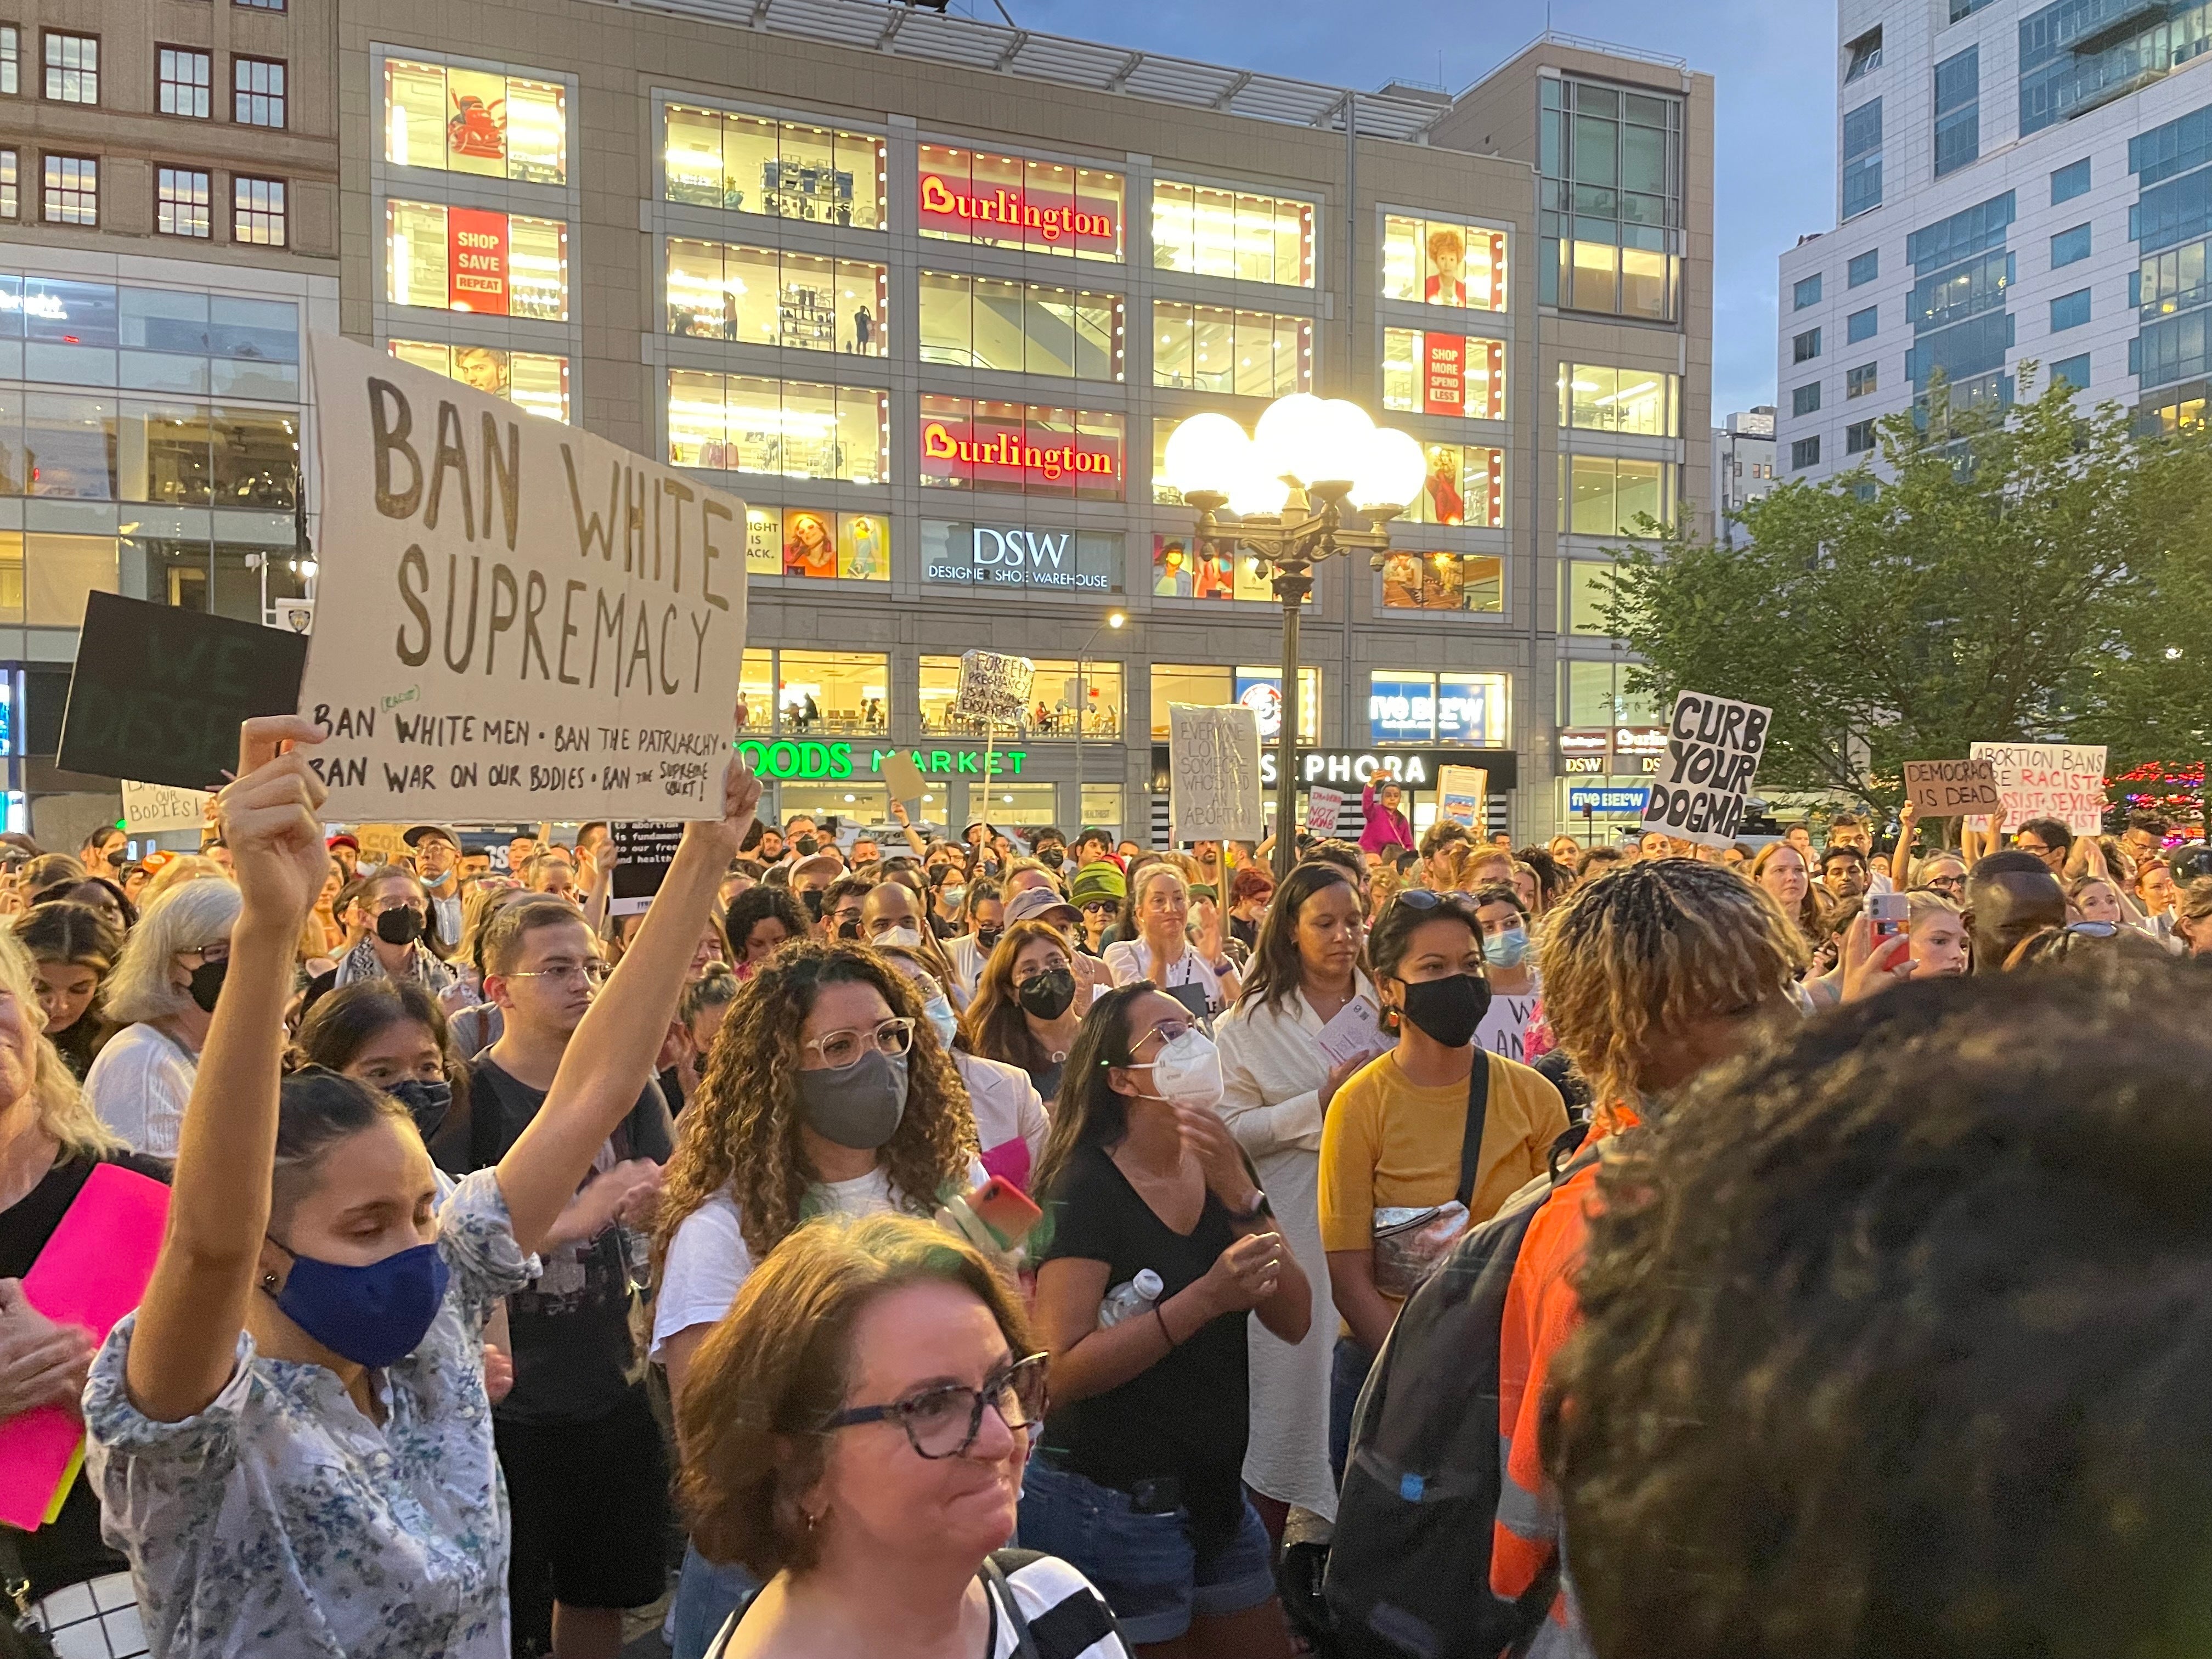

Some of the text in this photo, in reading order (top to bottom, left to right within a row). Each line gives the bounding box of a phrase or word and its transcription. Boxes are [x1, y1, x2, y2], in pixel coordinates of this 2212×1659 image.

[922, 176, 1111, 240] Burlington
[458, 232, 499, 250] SHOP
[458, 253, 500, 272] SAVE
[459, 277, 499, 290] REPEAT
[1431, 348, 1458, 362] SHOP
[1431, 362, 1458, 375] MORE
[1431, 376, 1459, 388] SPEND
[1435, 390, 1454, 401] LESS
[924, 422, 1113, 480] Burlington
[368, 377, 733, 611] BAN WHITE
[746, 522, 779, 533] IGHT
[751, 535, 761, 544] IS
[974, 528, 1070, 569] DSW
[929, 565, 1107, 588] DESIGNER SHOE WAREHOUSE
[397, 544, 711, 697] SUPREMACY
[313, 703, 720, 756] BAN WHITE MEN BAN THE PATRIARCHY
[1673, 697, 1767, 754] CURB
[1261, 754, 1426, 783] SPHORA
[1565, 757, 1602, 772] DSW
[1668, 740, 1757, 794] YOUR
[1976, 747, 2103, 772] ABORTION BANS
[308, 756, 368, 787] BAN
[383, 762, 436, 793] WAR
[450, 761, 477, 788] ON
[488, 764, 522, 787] OUR
[529, 764, 585, 792] BODIES
[602, 766, 630, 791] BAN
[659, 760, 709, 779] SUPREME
[1908, 761, 1993, 782] DEMOCRACY
[2020, 769, 2097, 791] RACIST
[156, 789, 180, 805] OUR
[1920, 785, 1997, 806] IS DEAD
[1644, 783, 1743, 839] DOGMA
[614, 832, 627, 841] is
